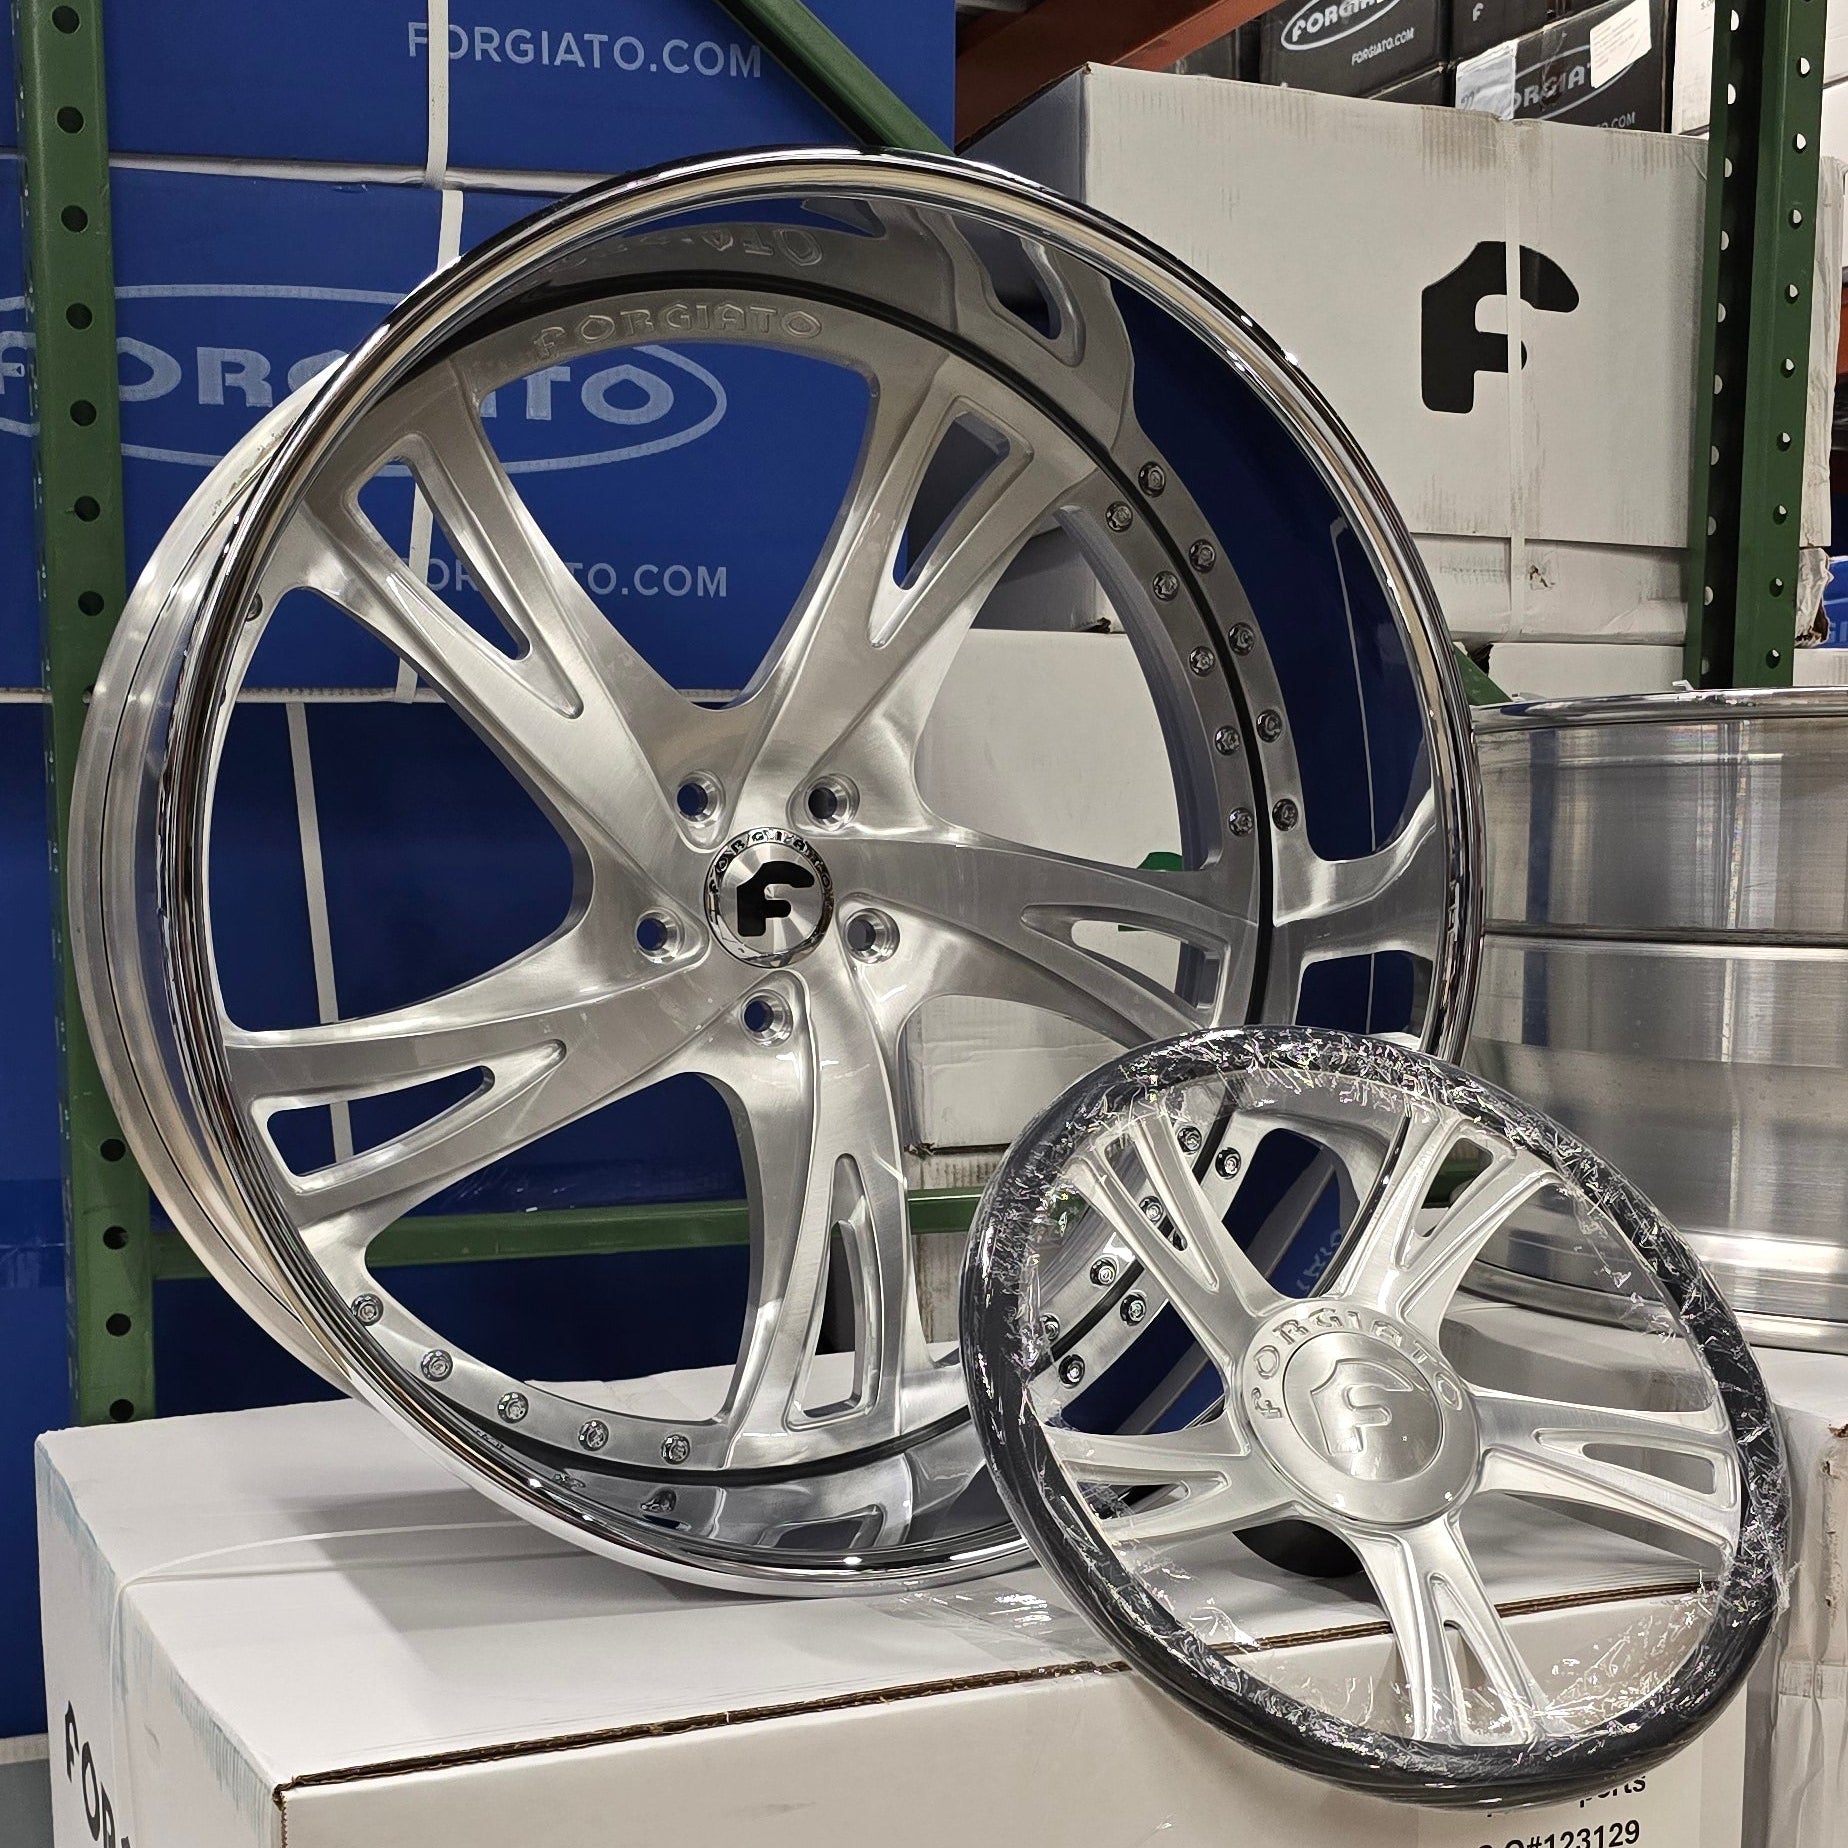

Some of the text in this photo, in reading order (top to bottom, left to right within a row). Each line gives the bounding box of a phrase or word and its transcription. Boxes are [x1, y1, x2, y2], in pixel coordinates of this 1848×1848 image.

[1291, 0, 1384, 42] FORGI
[408, 22, 761, 78] FORGIATO.COM
[533, 303, 823, 358] FORGIATO
[1250, 1307, 1463, 1420] FORGIATO
[65, 1700, 131, 1848] FOR
